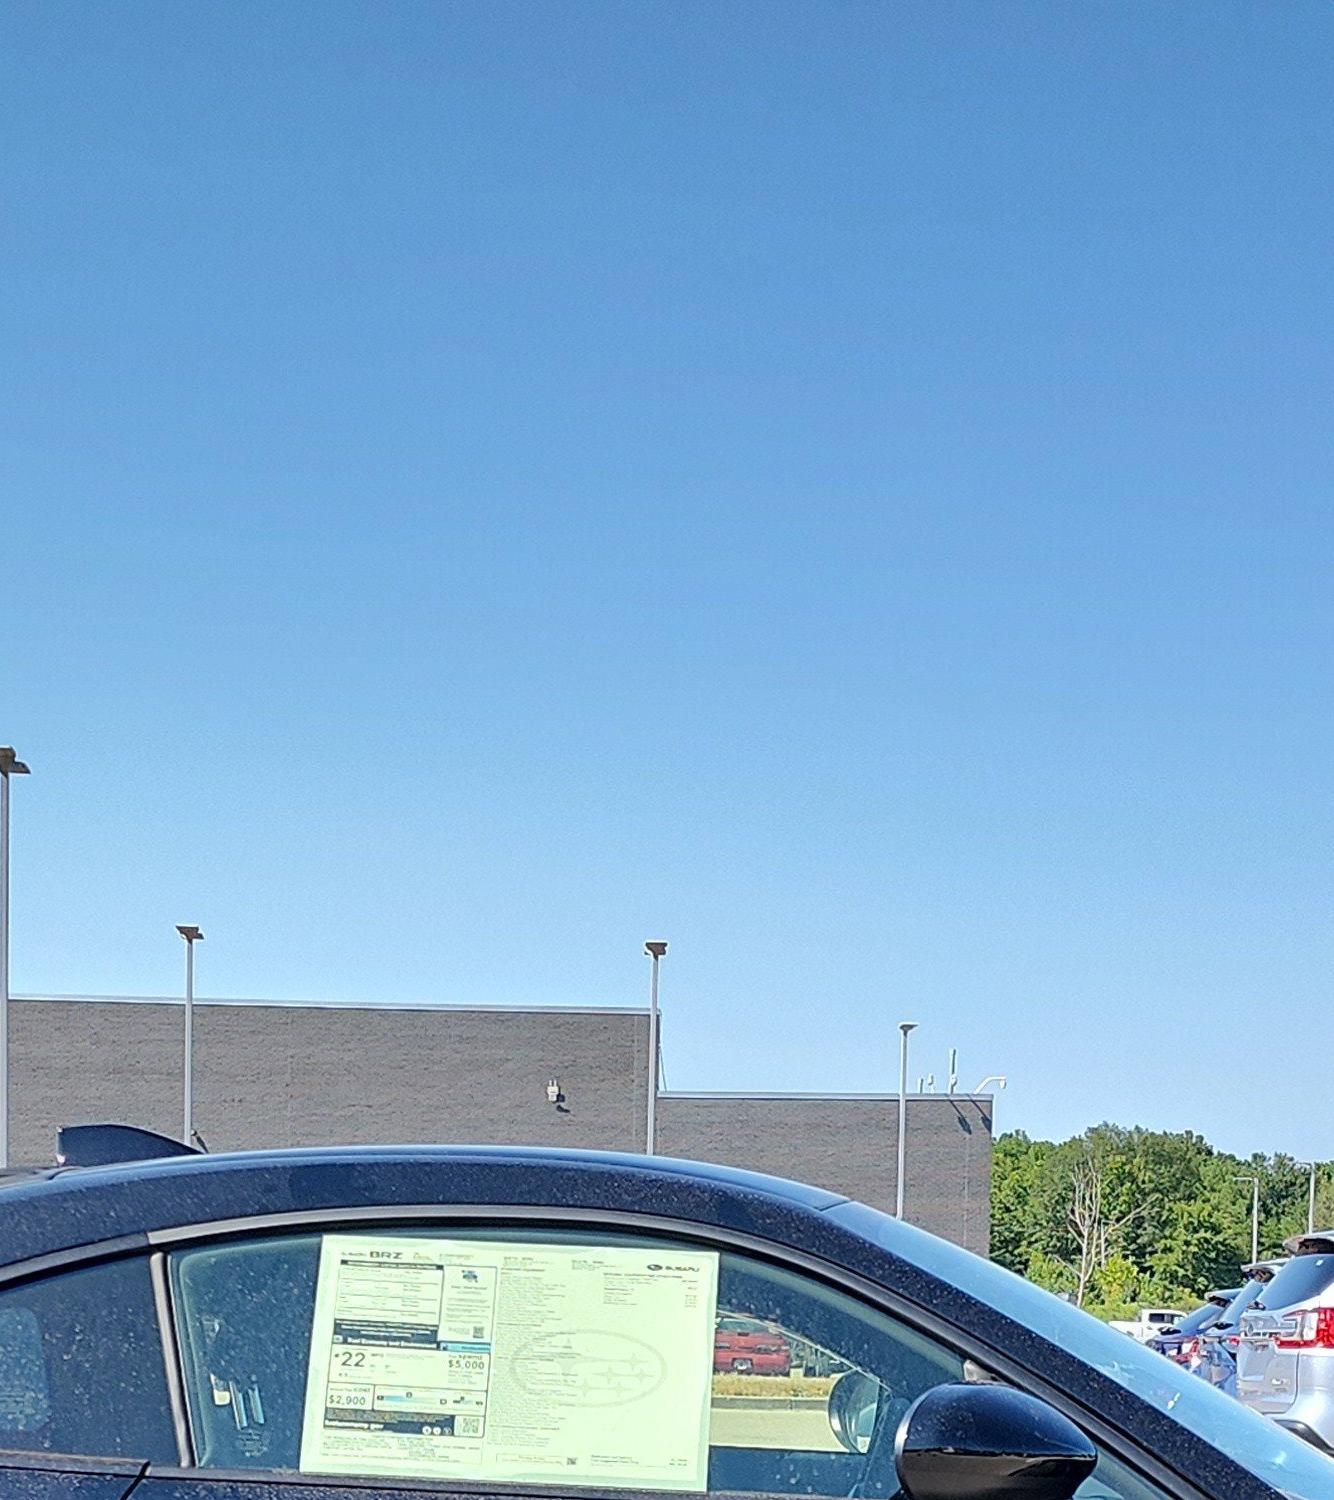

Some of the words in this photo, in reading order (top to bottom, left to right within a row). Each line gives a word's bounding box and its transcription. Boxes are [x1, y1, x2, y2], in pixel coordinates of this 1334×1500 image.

[370, 1251, 403, 1259] BRZ
[341, 1351, 366, 1368] 22
[448, 1359, 485, 1370] $5,000
[329, 1394, 366, 1406] $2,900
